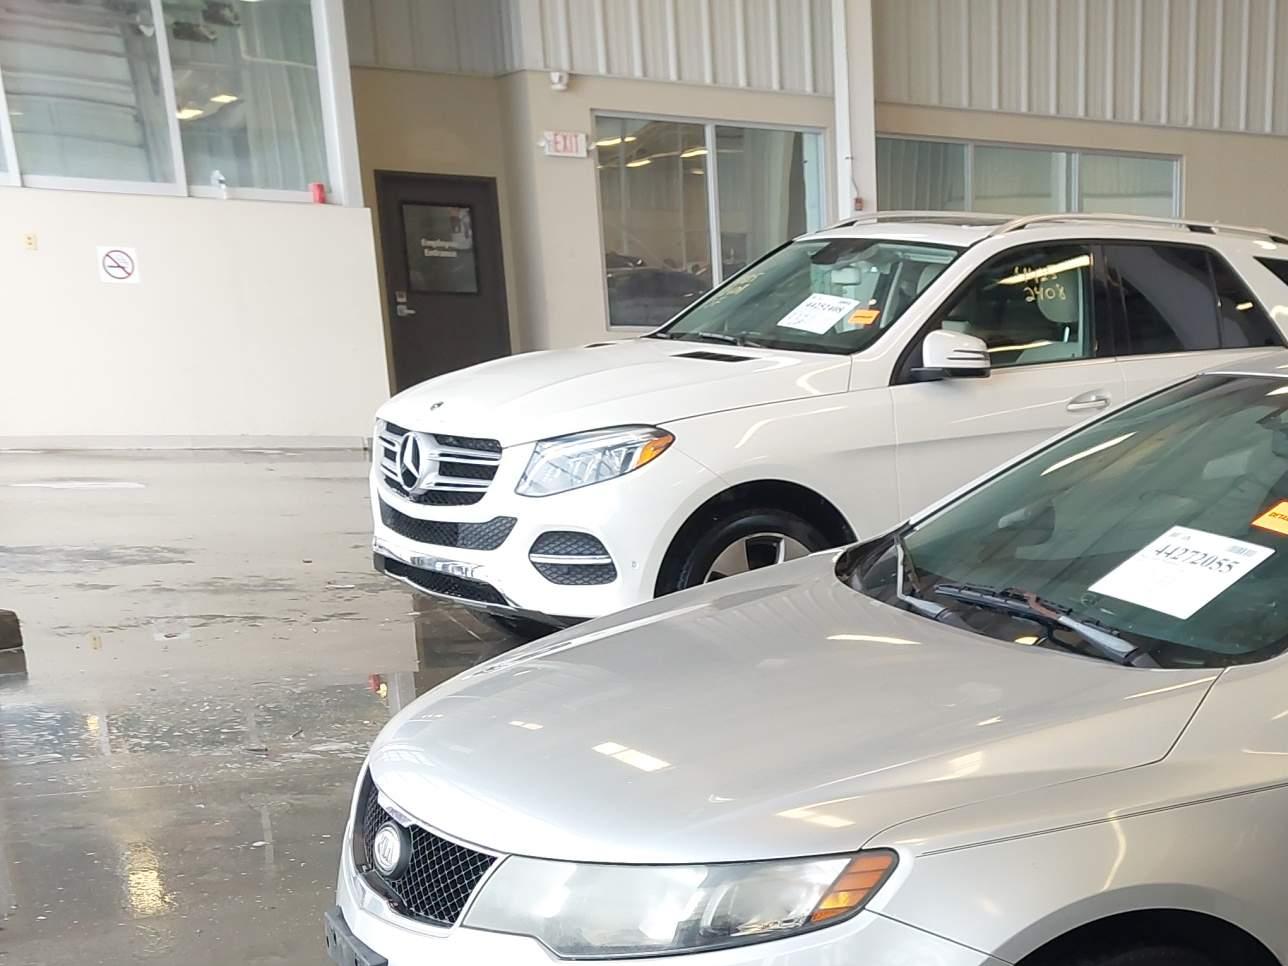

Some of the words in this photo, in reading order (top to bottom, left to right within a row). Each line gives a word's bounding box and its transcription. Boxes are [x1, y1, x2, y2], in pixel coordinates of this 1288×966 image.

[553, 132, 579, 154] EXIT
[1023, 283, 1067, 302] 2408
[1155, 544, 1240, 573] 44272055
